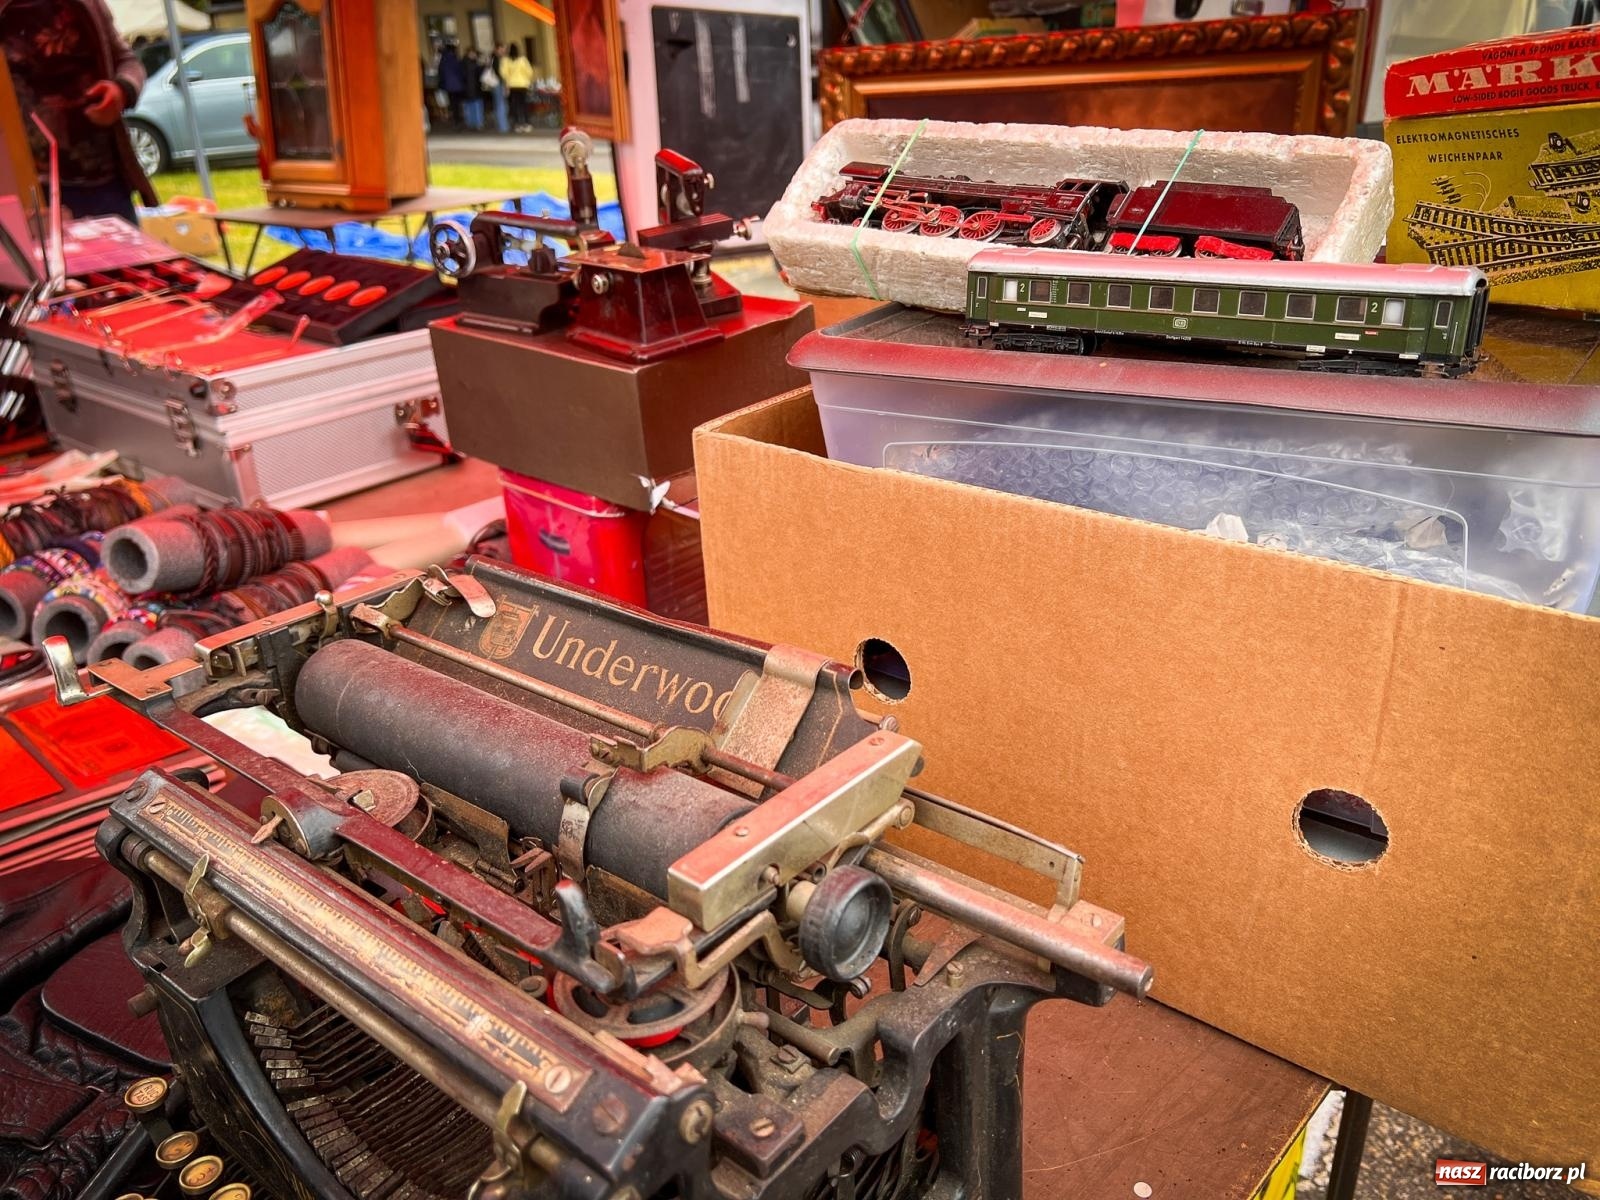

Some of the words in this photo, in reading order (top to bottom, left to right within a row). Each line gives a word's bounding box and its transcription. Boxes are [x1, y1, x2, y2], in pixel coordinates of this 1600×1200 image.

[1453, 91, 1497, 104] LOW-SIDED
[1527, 87, 1558, 97] GOODS
[1396, 128, 1520, 144] ELEKTROMAGNETISCHES
[1427, 151, 1503, 163] WEICHENPAAR
[1020, 283, 1025, 292] 2
[1371, 302, 1378, 313] 2
